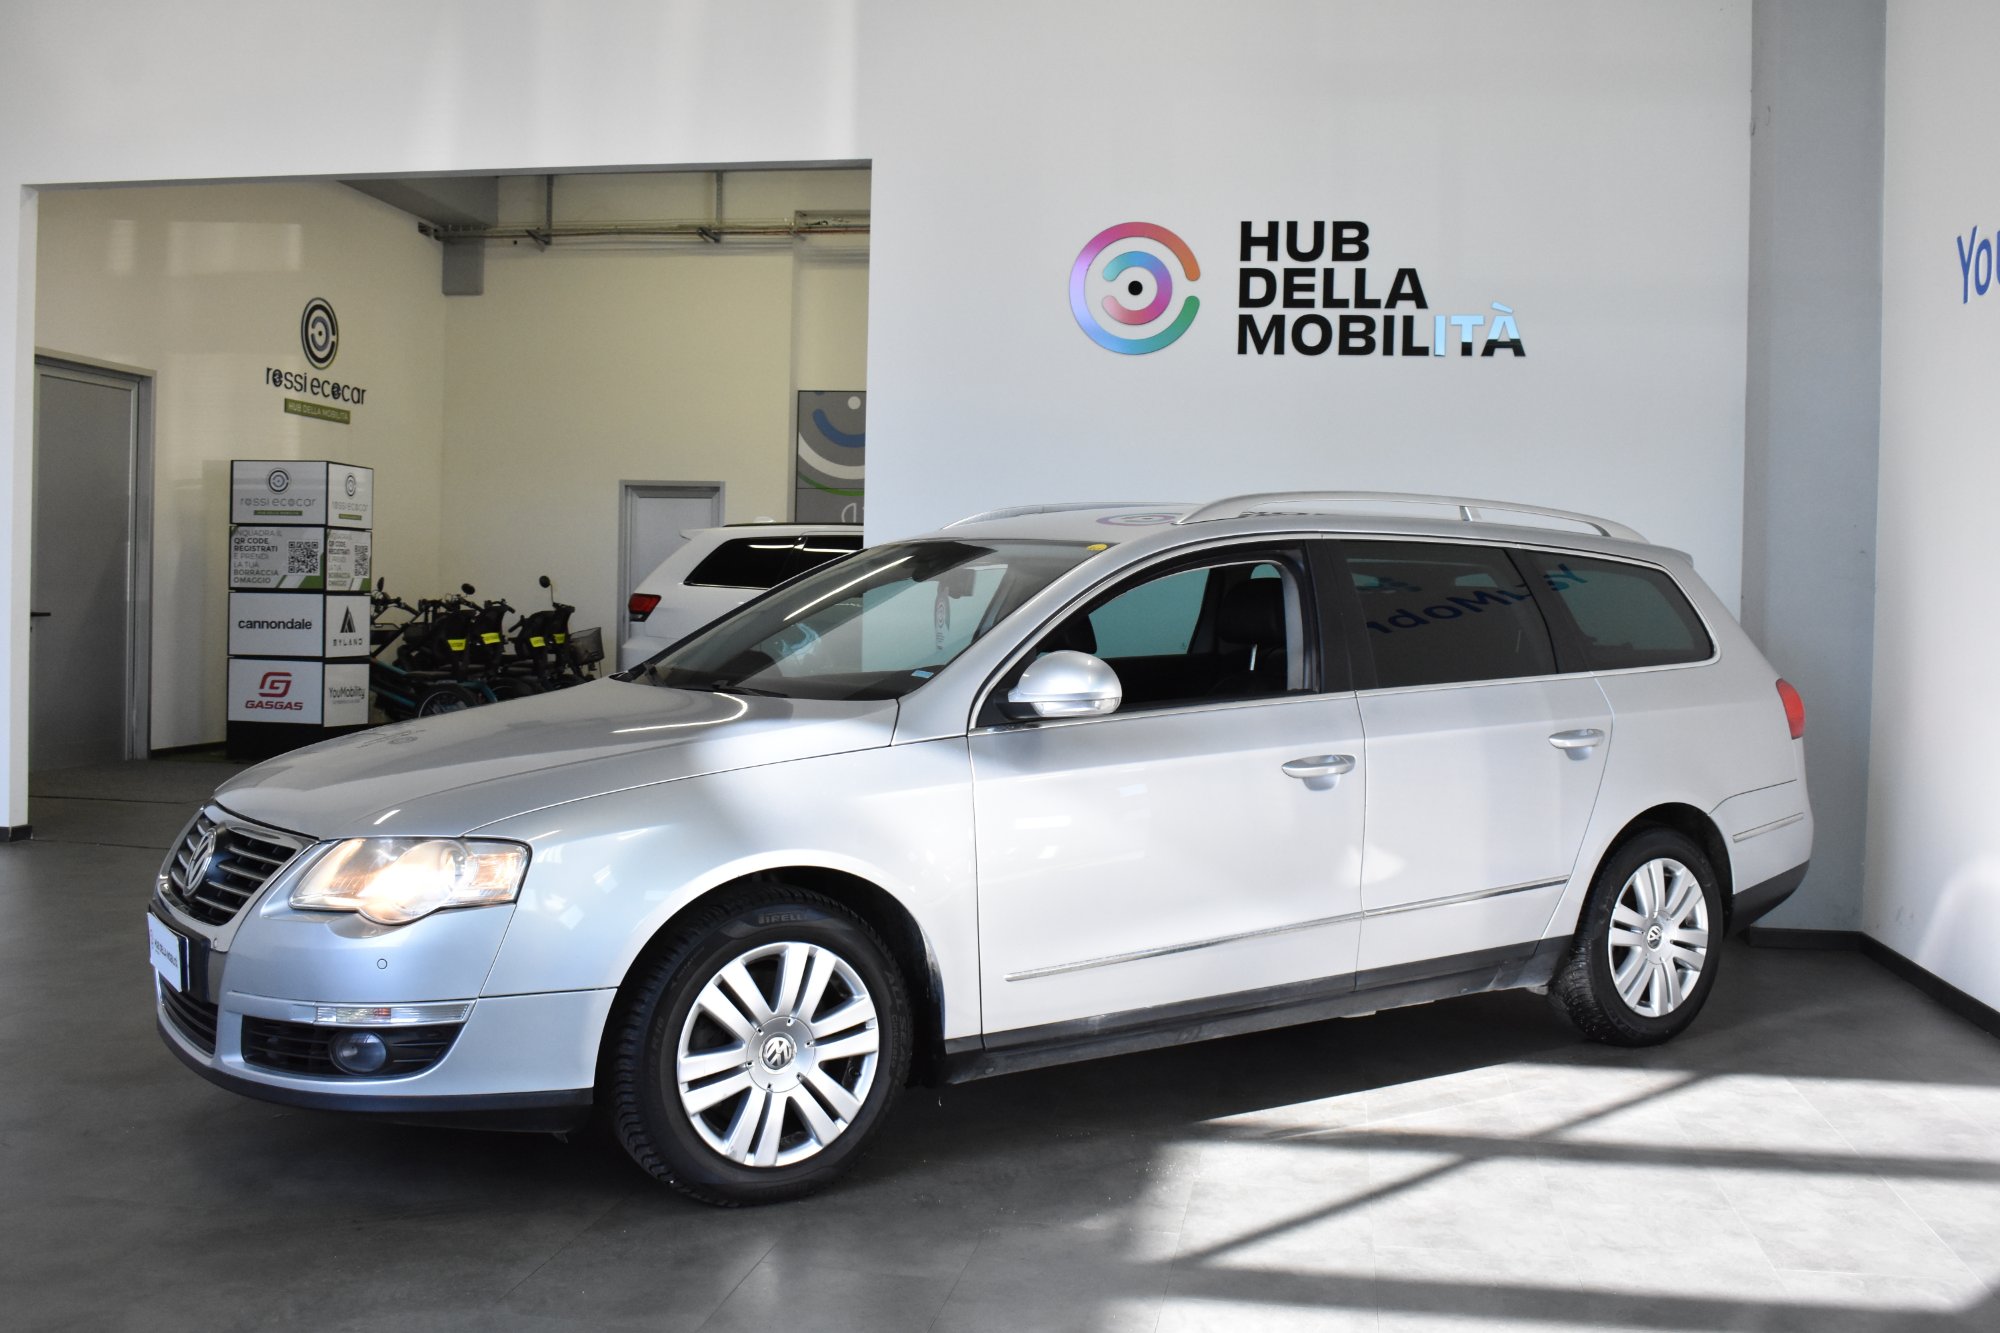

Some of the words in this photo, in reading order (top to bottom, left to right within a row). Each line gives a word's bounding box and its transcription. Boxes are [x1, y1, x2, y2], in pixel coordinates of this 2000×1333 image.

[1240, 220, 1370, 262] HUB
[1956, 225, 2000, 304] Yo
[1238, 267, 1428, 309] DELLA
[1237, 301, 1526, 357] MOBILITÀ
[238, 618, 312, 630] cannondale
[245, 700, 303, 711] GASGAS
